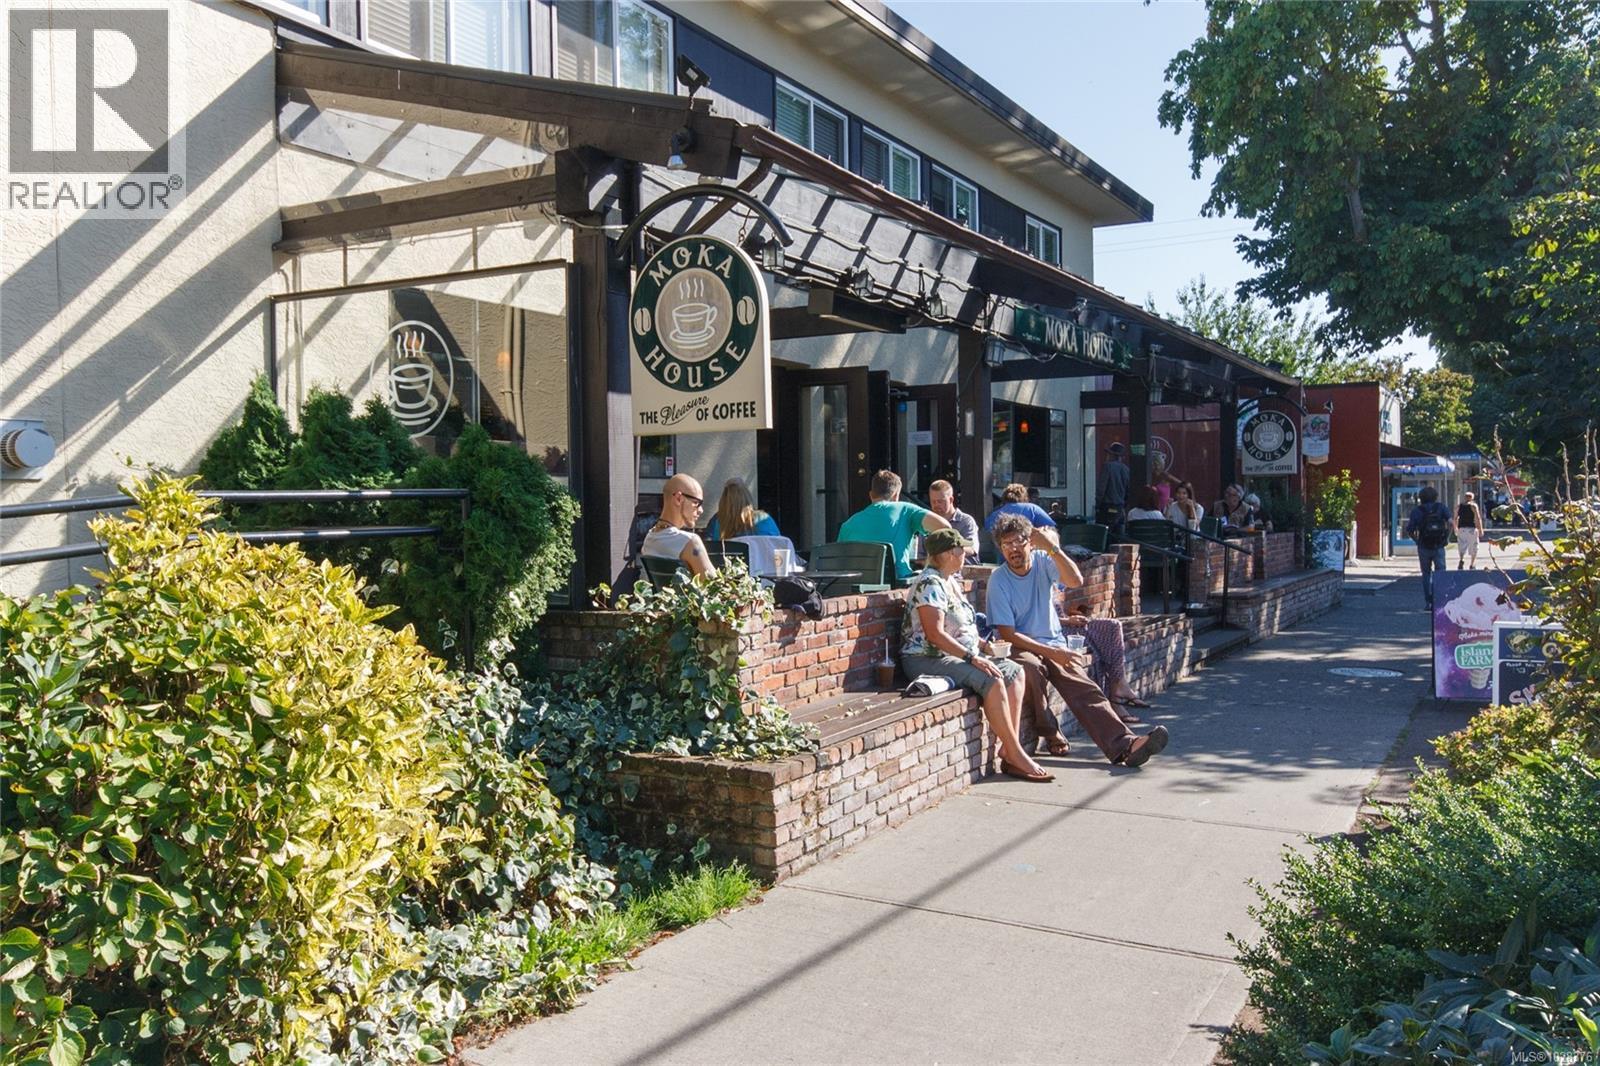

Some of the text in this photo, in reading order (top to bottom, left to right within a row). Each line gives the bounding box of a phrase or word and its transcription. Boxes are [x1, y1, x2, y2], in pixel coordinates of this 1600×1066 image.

[650, 243, 734, 287] MOKA
[1045, 317, 1114, 363] MOKA HOUSE
[644, 340, 746, 388] HOUSE
[639, 395, 756, 426] THE Pleasure OF COFFEE
[1251, 414, 1286, 427] MOKA
[1248, 446, 1290, 460] HOUSE
